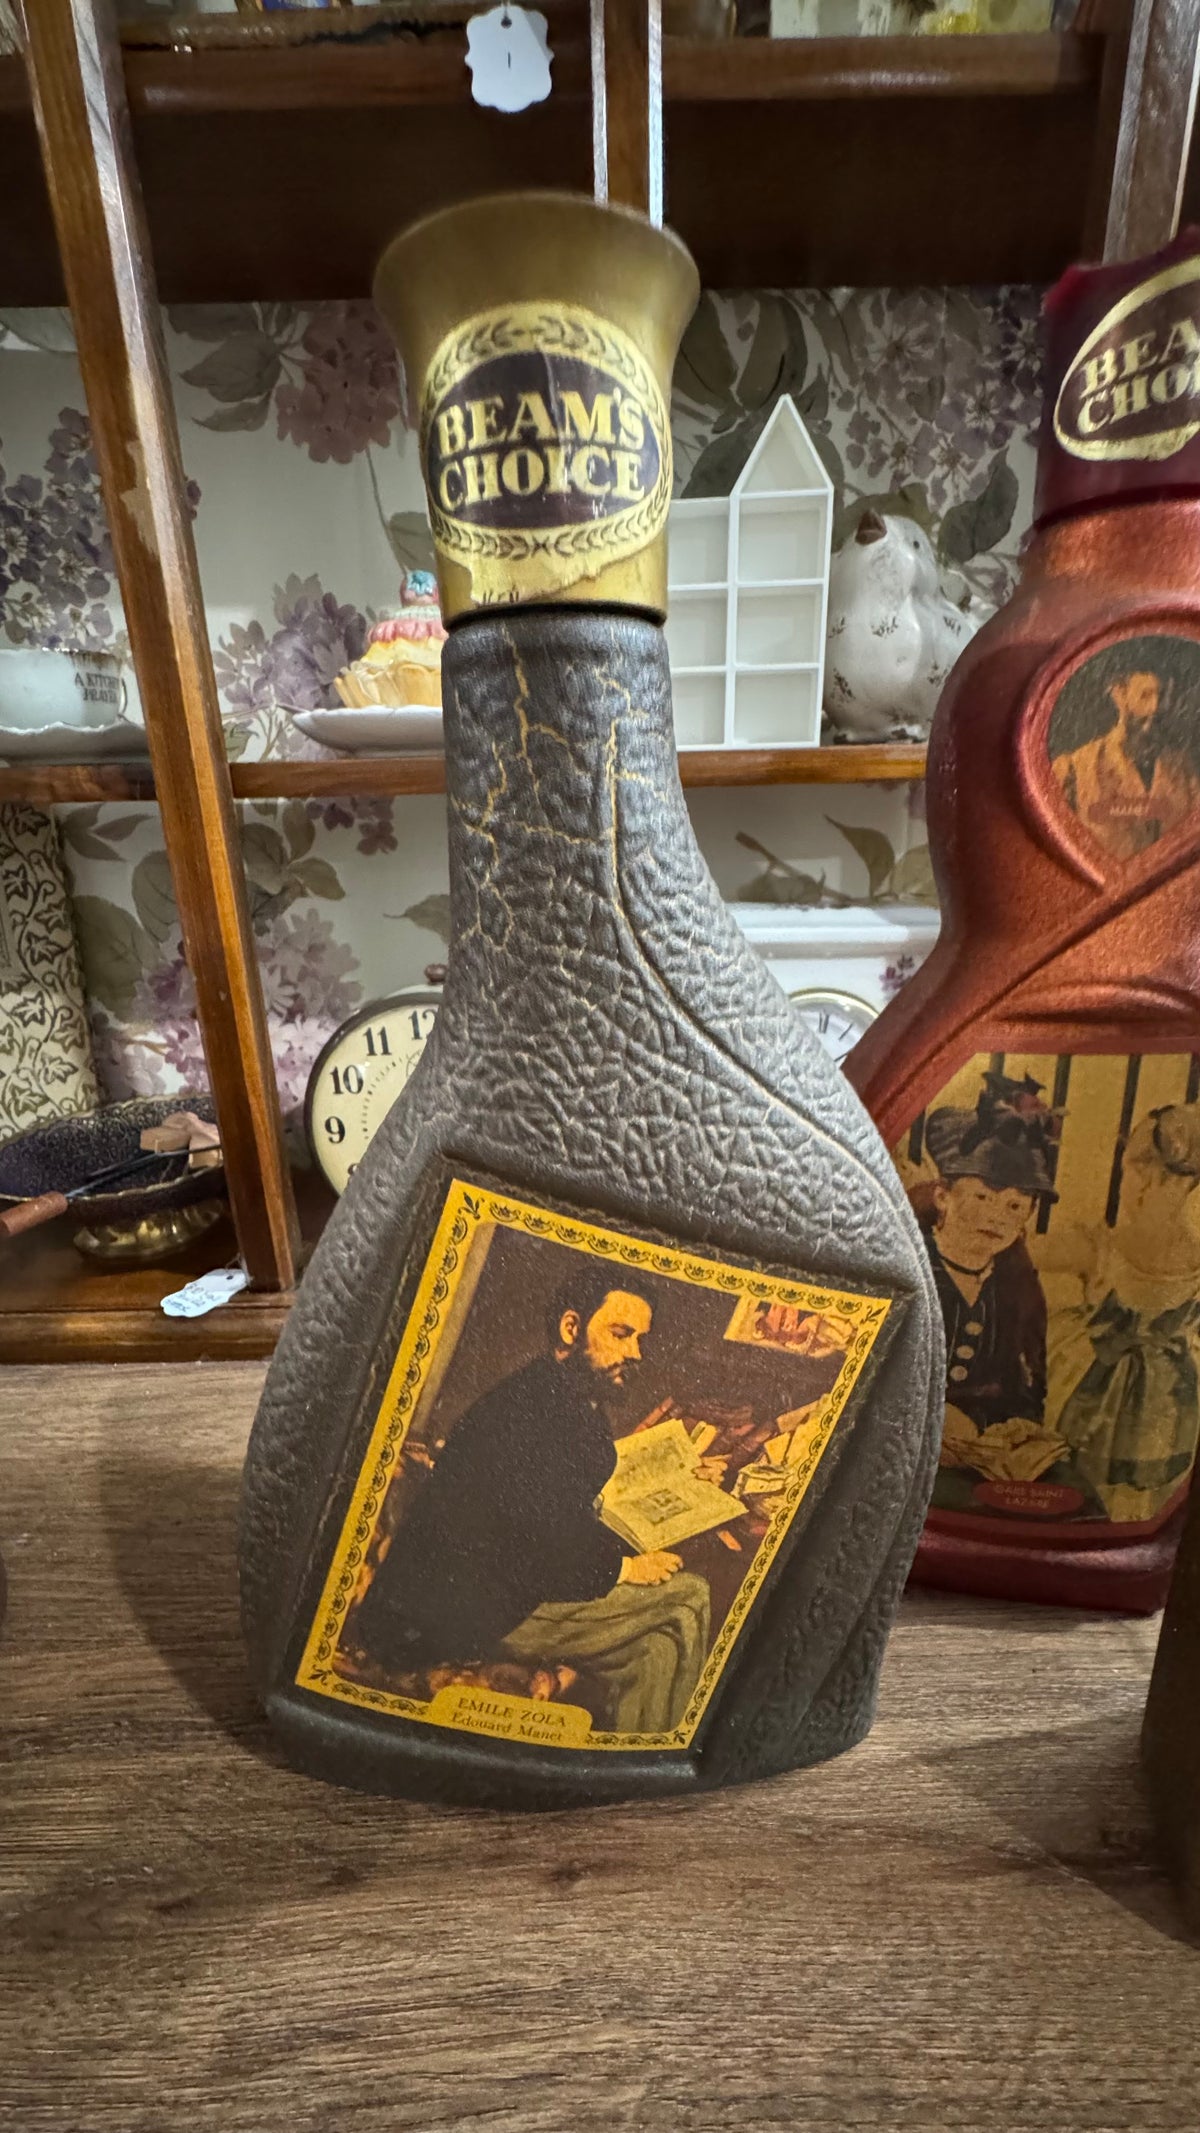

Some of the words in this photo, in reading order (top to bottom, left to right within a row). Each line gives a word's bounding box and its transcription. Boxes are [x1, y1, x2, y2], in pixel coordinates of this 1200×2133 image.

[437, 387, 646, 458] BEAM'S
[439, 445, 646, 511] CHOICE
[362, 1026, 393, 1057] 11
[329, 1063, 364, 1095] 10
[324, 1115, 346, 1144] 9
[452, 1711, 513, 1733] Edouard
[517, 1723, 563, 1742] Manet
[458, 1697, 514, 1719] EMILE
[520, 1709, 567, 1727] ZOLA
